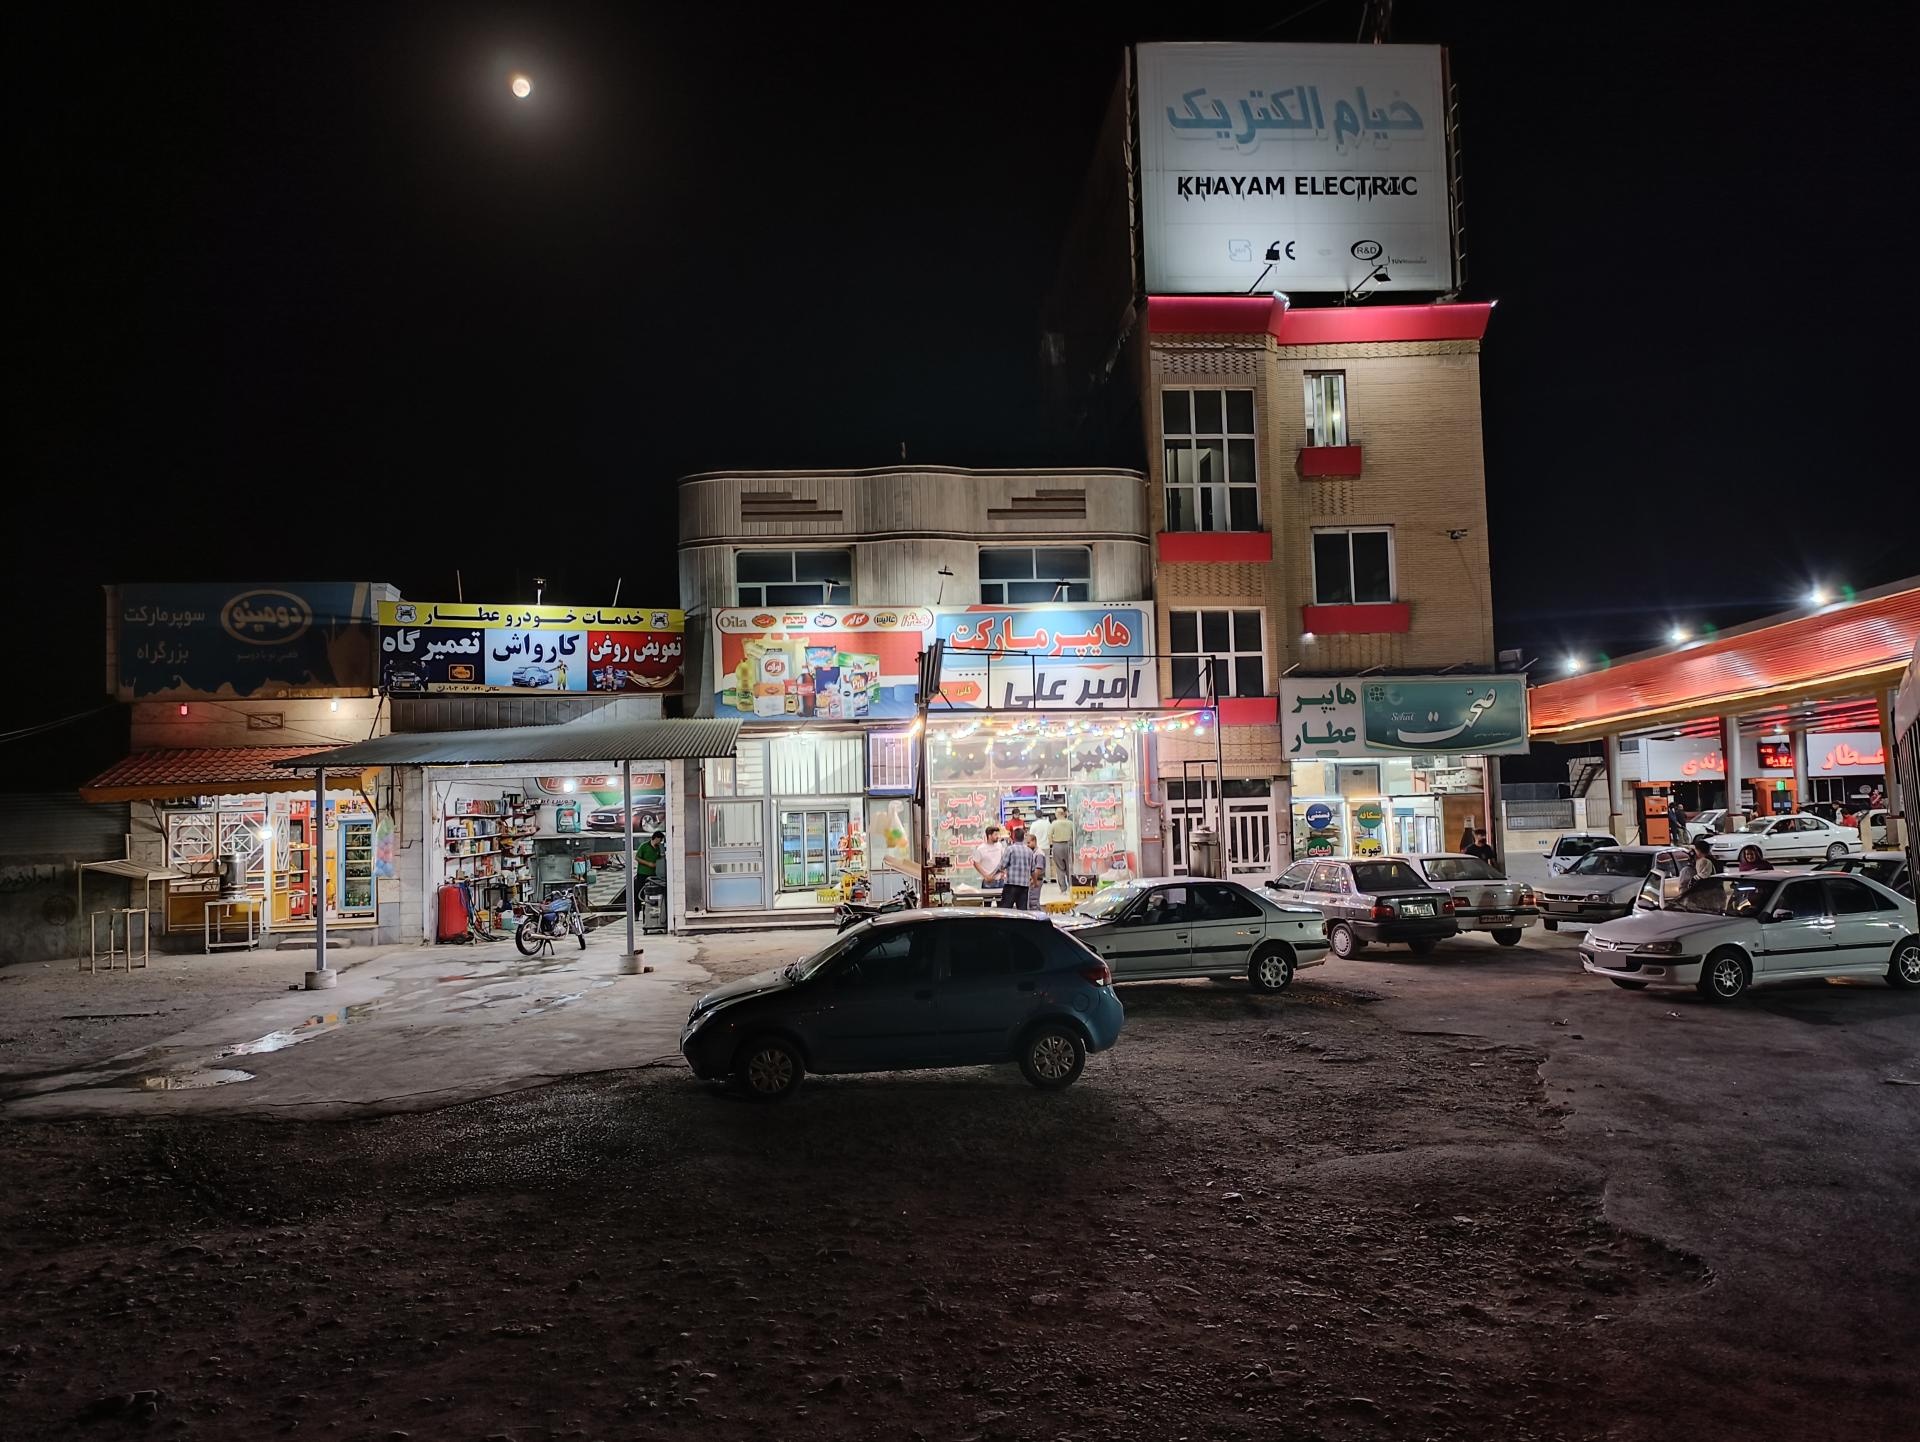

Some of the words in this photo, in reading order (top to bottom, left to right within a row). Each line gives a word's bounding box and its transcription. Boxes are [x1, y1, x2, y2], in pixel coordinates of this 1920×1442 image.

[1166, 85, 1325, 145] الکتریک
[1333, 86, 1424, 145] خیام
[1177, 176, 1285, 197] KHAYAM
[1295, 176, 1418, 197] ELECTRIC
[1356, 246, 1377, 254] R&D
[232, 600, 303, 633] دومینو
[423, 605, 500, 625] عطار
[505, 608, 577, 629] خودرو
[583, 608, 644, 626] خدمات
[720, 616, 747, 628] Oila
[493, 632, 580, 663] کارواش
[589, 636, 630, 663] روغن
[634, 635, 682, 664] تعویض
[949, 616, 1050, 661] مارکت
[1049, 613, 1131, 658] هایپر
[1004, 672, 1067, 708] علی
[1075, 669, 1141, 708] امیر
[1292, 682, 1357, 713] هایپر
[1290, 721, 1357, 752] عطار
[1308, 810, 1331, 821] بستنی
[1361, 842, 1382, 857] قهوه
